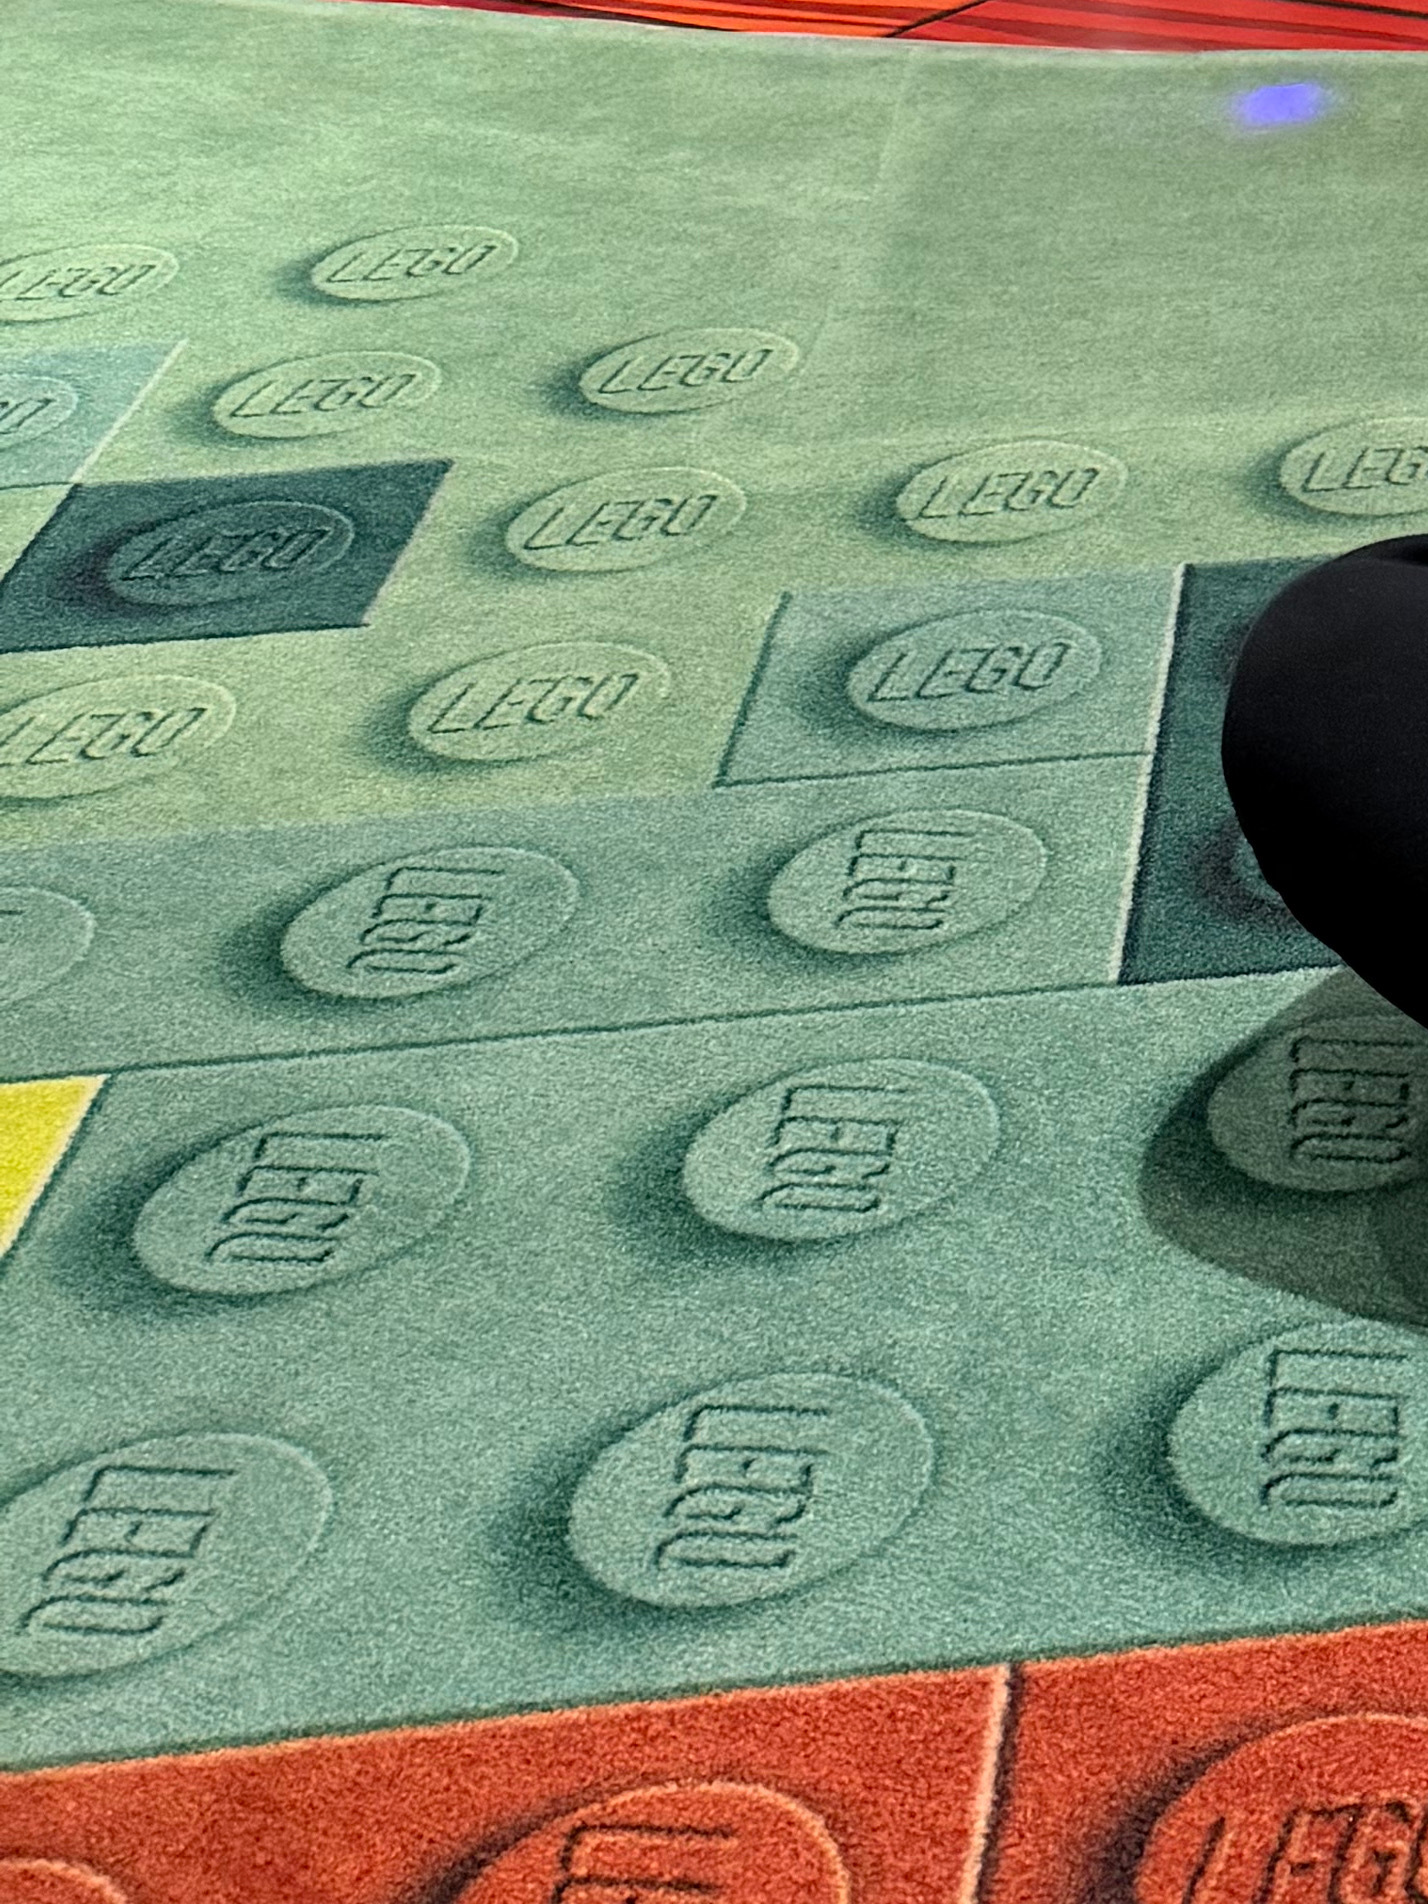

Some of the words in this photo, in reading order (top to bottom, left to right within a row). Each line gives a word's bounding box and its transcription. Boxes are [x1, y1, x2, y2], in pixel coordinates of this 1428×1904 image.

[325, 243, 498, 285] LEGO
[230, 373, 422, 420] LEGO
[598, 347, 774, 395] LEGO
[523, 493, 719, 551] LEGO
[918, 467, 1102, 520] LEGO
[119, 525, 329, 583] LEGO
[430, 672, 641, 735] LEGO
[867, 641, 1073, 705] LEGO
[833, 828, 975, 931] LEGO
[346, 865, 507, 977] LEGO
[758, 1084, 908, 1215] LEGO
[202, 1132, 393, 1266] LEGO
[1260, 1349, 1411, 1511] LEGO
[652, 1403, 832, 1571] LEGO
[19, 1462, 240, 1638] LEGO
